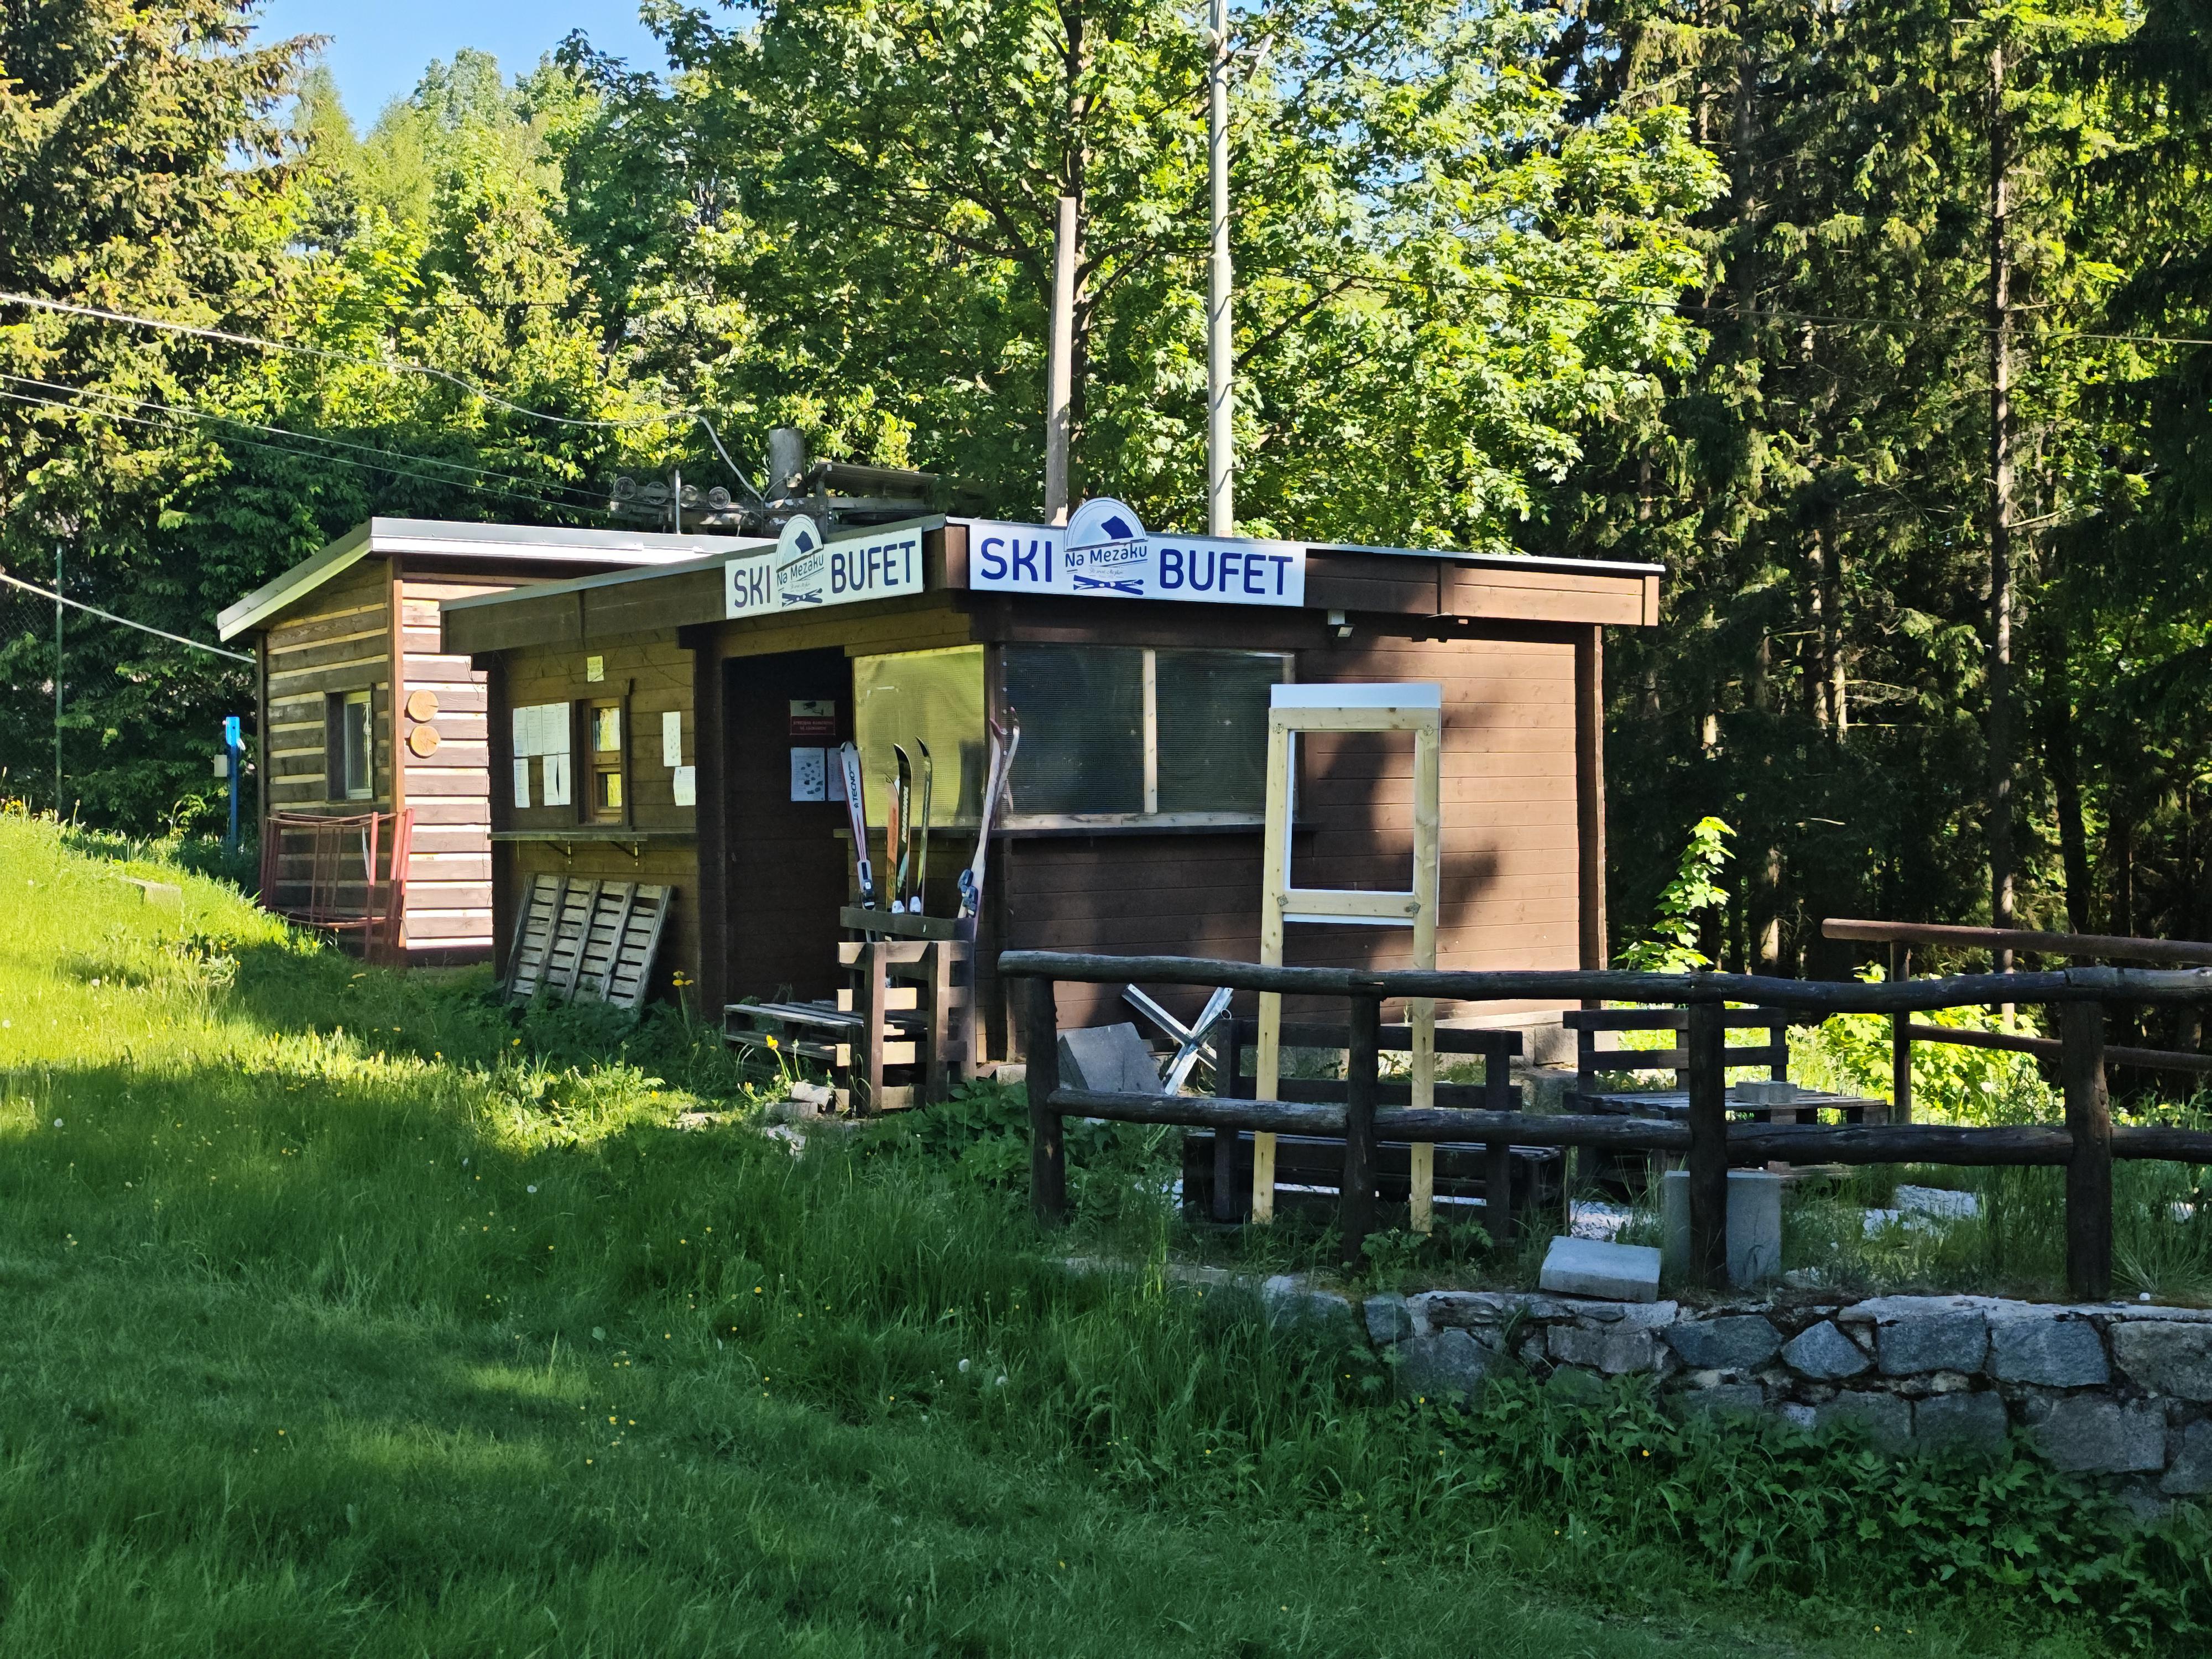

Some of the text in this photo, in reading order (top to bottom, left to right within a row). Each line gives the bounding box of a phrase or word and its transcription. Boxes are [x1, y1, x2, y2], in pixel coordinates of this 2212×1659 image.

[734, 540, 916, 608] SKI BUFET
[980, 538, 1293, 596] SKI BUFET
[1065, 552, 1084, 568] Na
[777, 571, 787, 587] Na
[849, 771, 858, 802] TECNO
